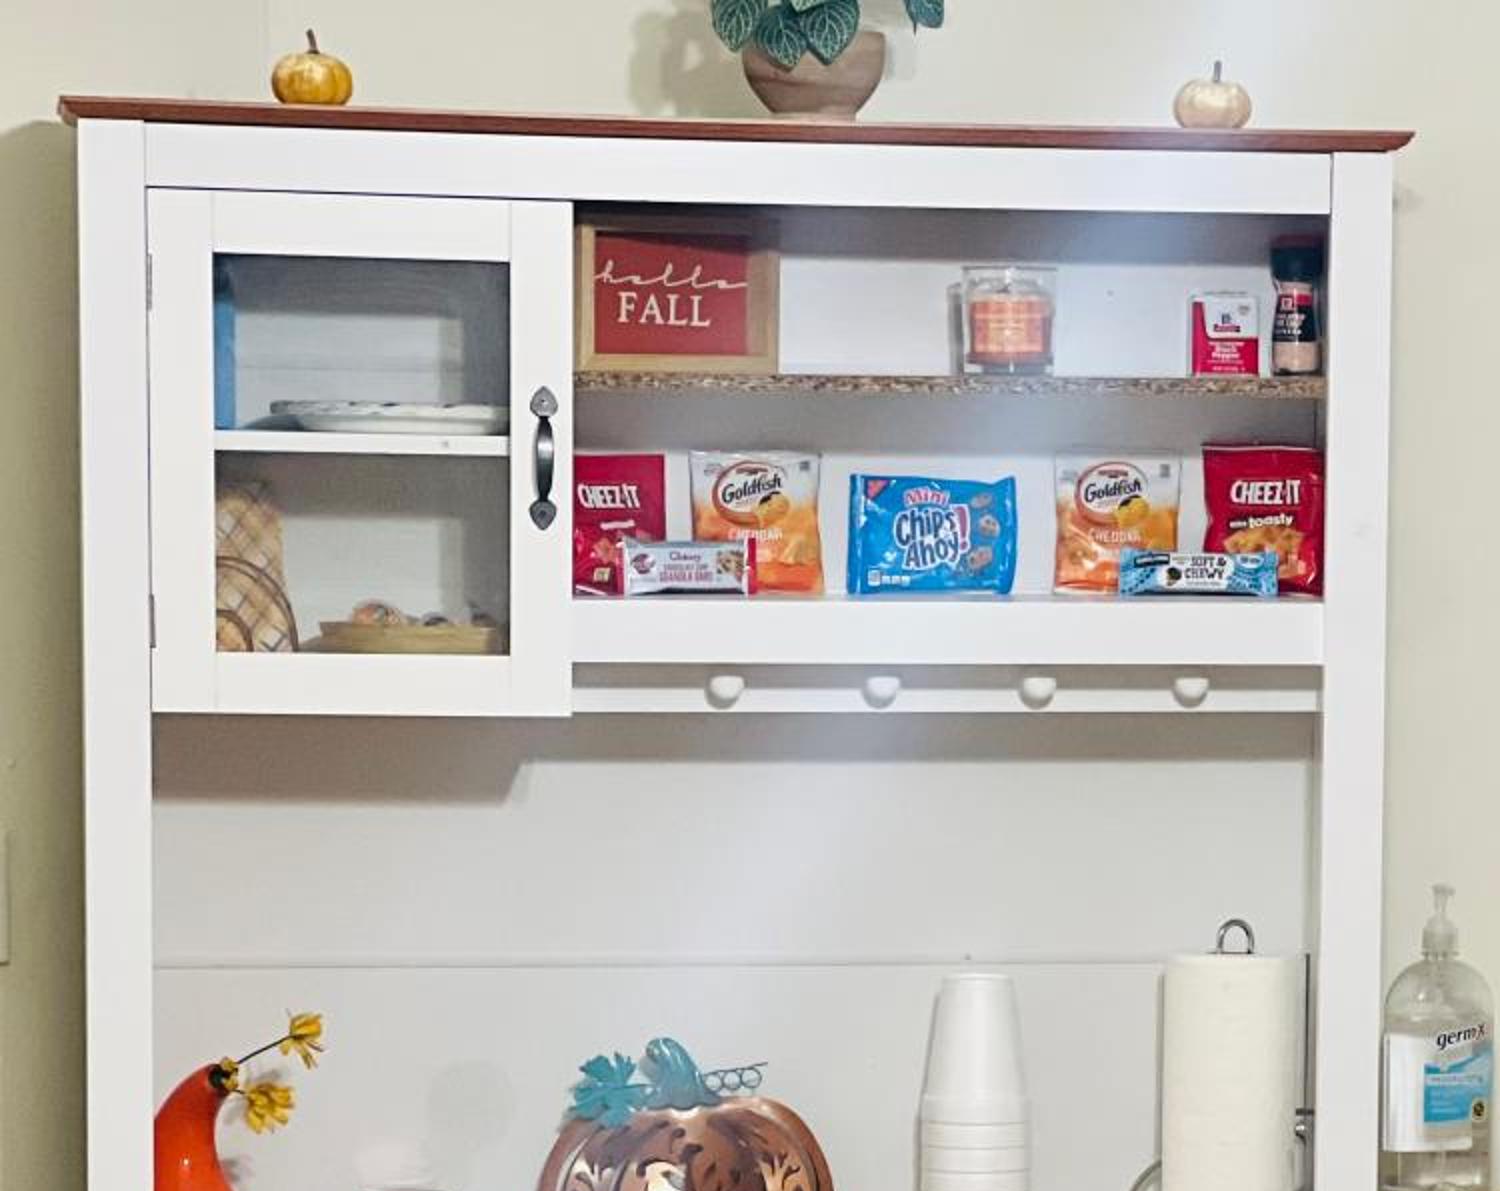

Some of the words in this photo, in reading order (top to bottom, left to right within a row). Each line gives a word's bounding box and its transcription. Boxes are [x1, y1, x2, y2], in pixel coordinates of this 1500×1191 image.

[594, 259, 748, 289] hello
[617, 291, 711, 327] FALL
[721, 474, 782, 504] Goldfish
[1084, 479, 1142, 503] Goldfish
[1229, 479, 1301, 505] CHEEZ-IT
[895, 509, 957, 546] Chips
[1183, 568, 1225, 580] CHEWY
